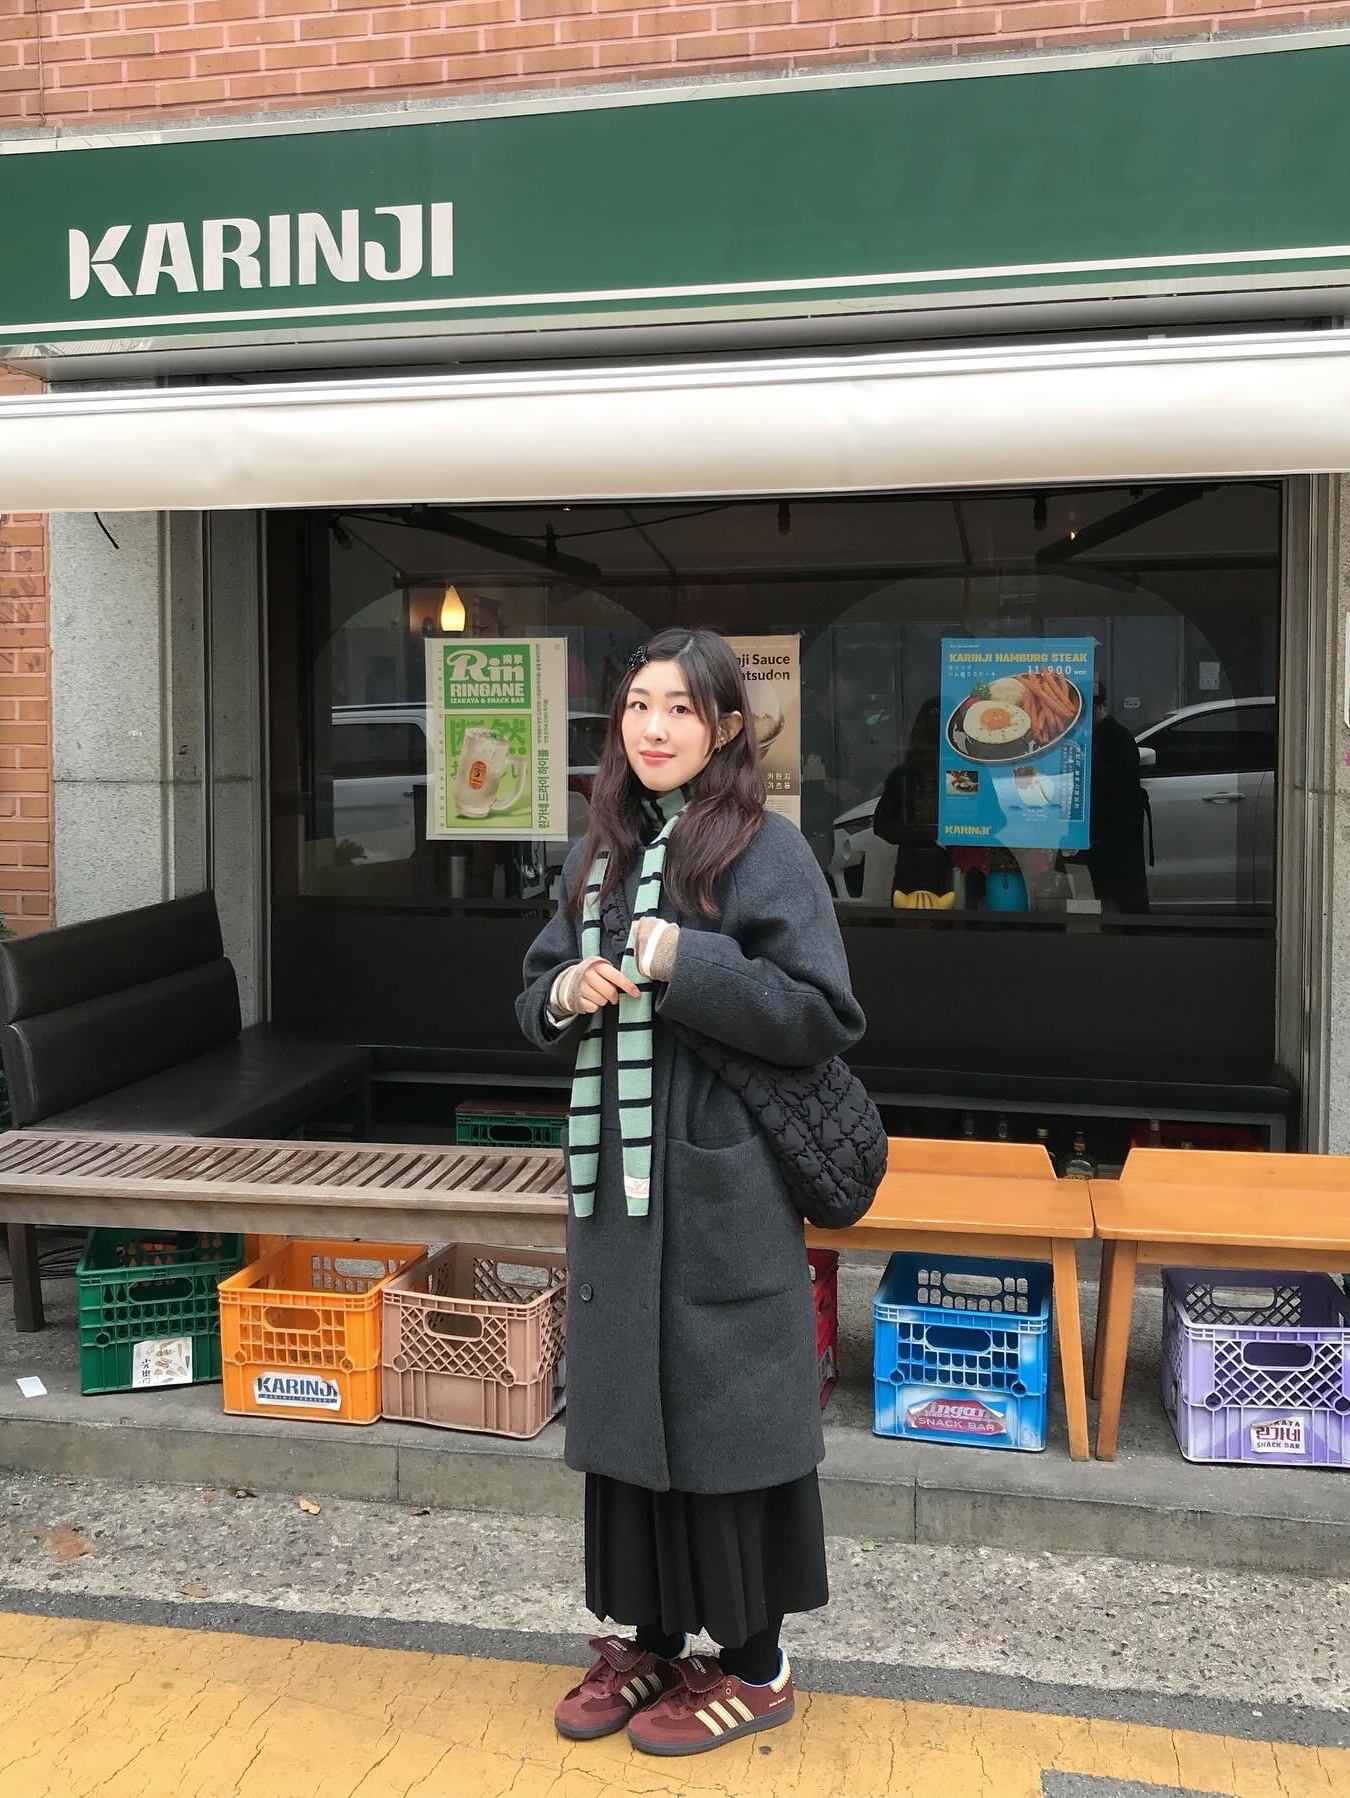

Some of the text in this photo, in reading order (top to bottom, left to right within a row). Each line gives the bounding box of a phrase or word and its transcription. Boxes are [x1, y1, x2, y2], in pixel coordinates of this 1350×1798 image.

[68, 202, 454, 300] KARINJI
[752, 653, 790, 665] Sauce
[949, 652, 1088, 663] KARINJI HAMBURG STEAK
[447, 649, 525, 682] Rin
[1027, 664, 1072, 677] 11,900
[450, 683, 525, 697] RINGANE
[537, 776, 549, 803] 드라이
[537, 803, 549, 829] 린가네
[918, 1417, 996, 1432] SNACK BAR
[1271, 1419, 1301, 1427] KAYA
[1256, 1426, 1301, 1442] 린가네
